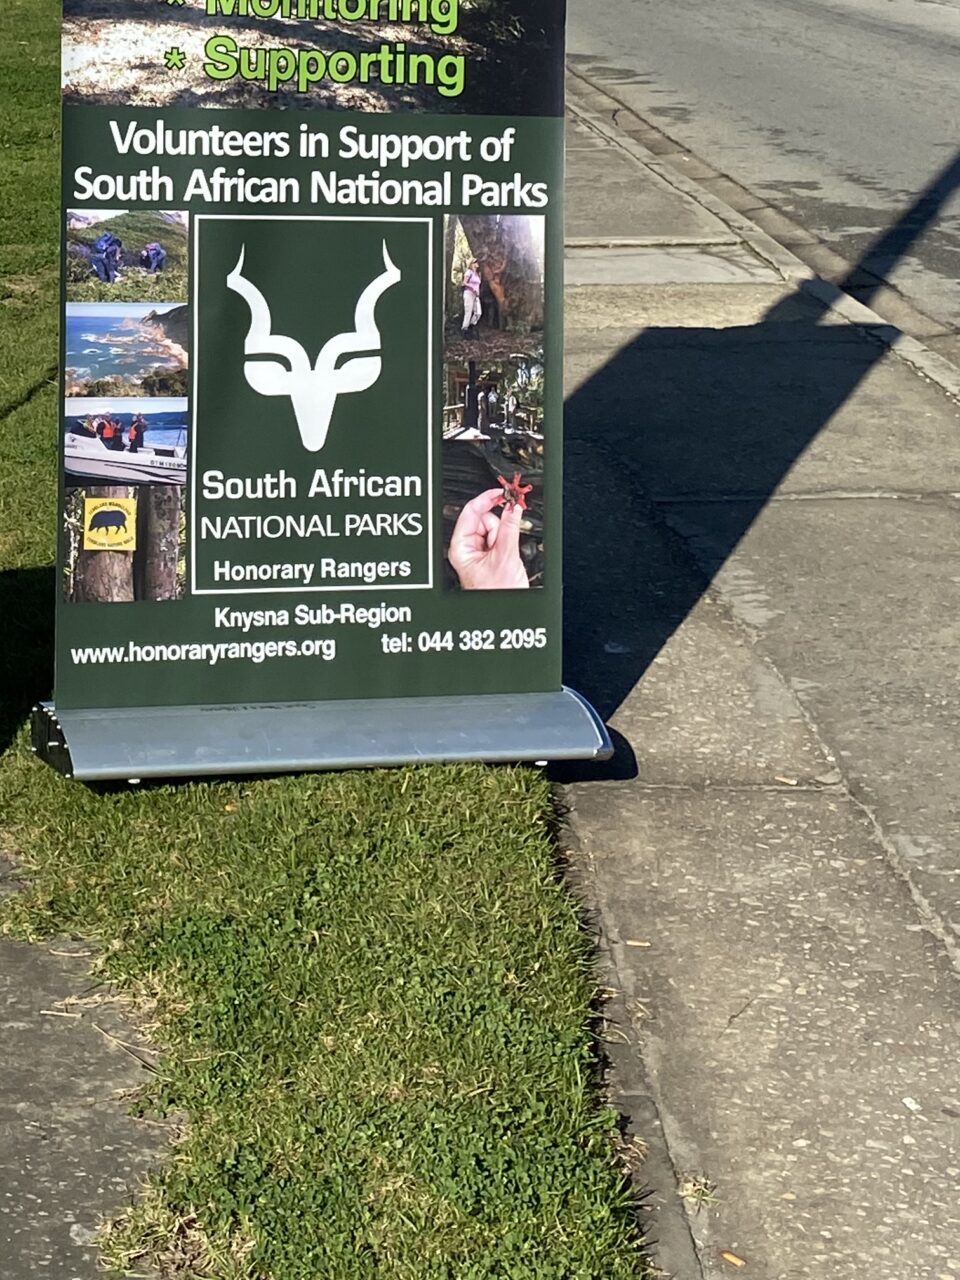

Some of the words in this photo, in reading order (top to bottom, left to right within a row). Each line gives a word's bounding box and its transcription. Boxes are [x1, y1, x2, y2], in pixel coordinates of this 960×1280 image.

[205, 34, 466, 96] Supporting
[109, 119, 290, 158] Volunteers
[299, 123, 329, 158] in
[338, 125, 472, 168] Support
[479, 127, 516, 162] of
[73, 165, 174, 202] South
[182, 166, 300, 203] African
[310, 170, 452, 206] National
[461, 172, 549, 208] Parks
[202, 469, 297, 500] South
[307, 468, 422, 498] African
[200, 514, 341, 540] NATIONAL
[344, 512, 423, 537] PARKS
[213, 560, 315, 585] Honorary
[320, 557, 412, 583] Rangers
[214, 606, 290, 633] Knysna
[294, 601, 412, 629] Sub-Region
[70, 639, 336, 666] www.honoraryrangers.org
[380, 631, 413, 654] tel:
[417, 630, 455, 652] 044
[458, 629, 496, 651] 382
[499, 627, 547, 650] 2095
